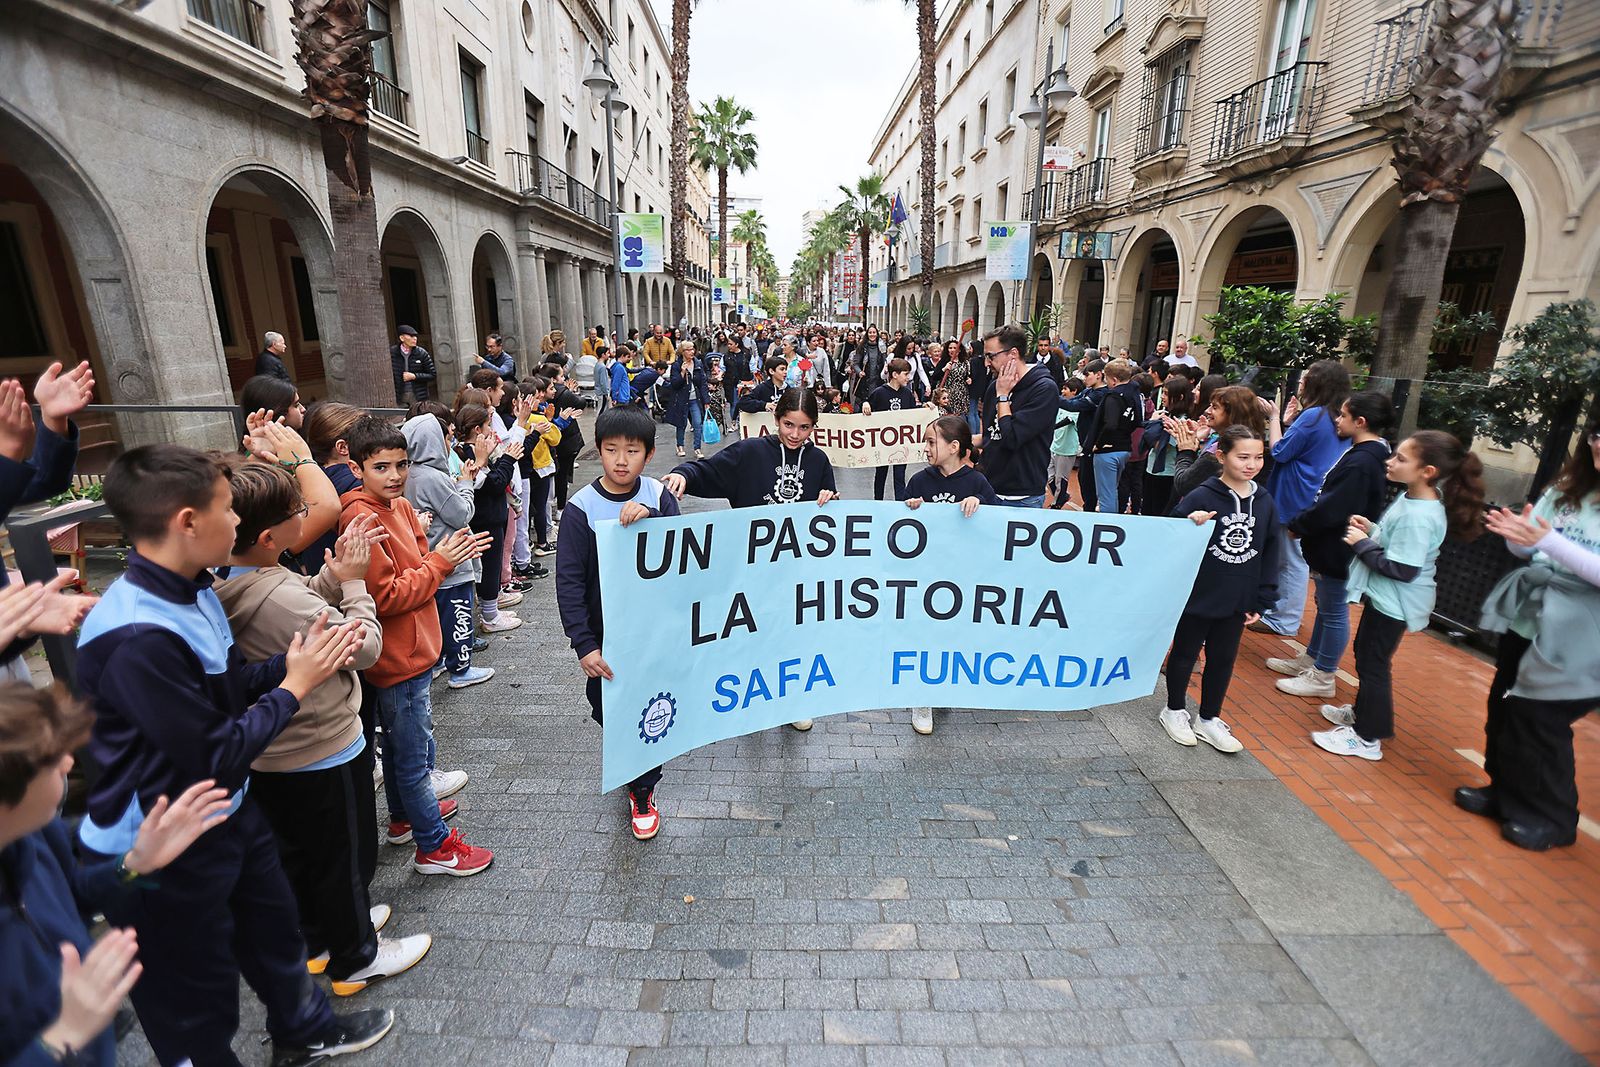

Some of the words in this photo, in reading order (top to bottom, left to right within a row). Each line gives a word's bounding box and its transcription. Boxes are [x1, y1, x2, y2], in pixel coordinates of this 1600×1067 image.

[814, 424, 925, 450] EHISTORI
[636, 523, 714, 580] UN
[747, 514, 928, 565] PASEO
[1003, 520, 1126, 567] POR
[450, 599, 474, 643] READY!
[691, 591, 758, 647] LA
[795, 577, 1069, 629] HISTORIA
[711, 653, 836, 713] SAFA
[892, 650, 1131, 688] FUNCADIA
